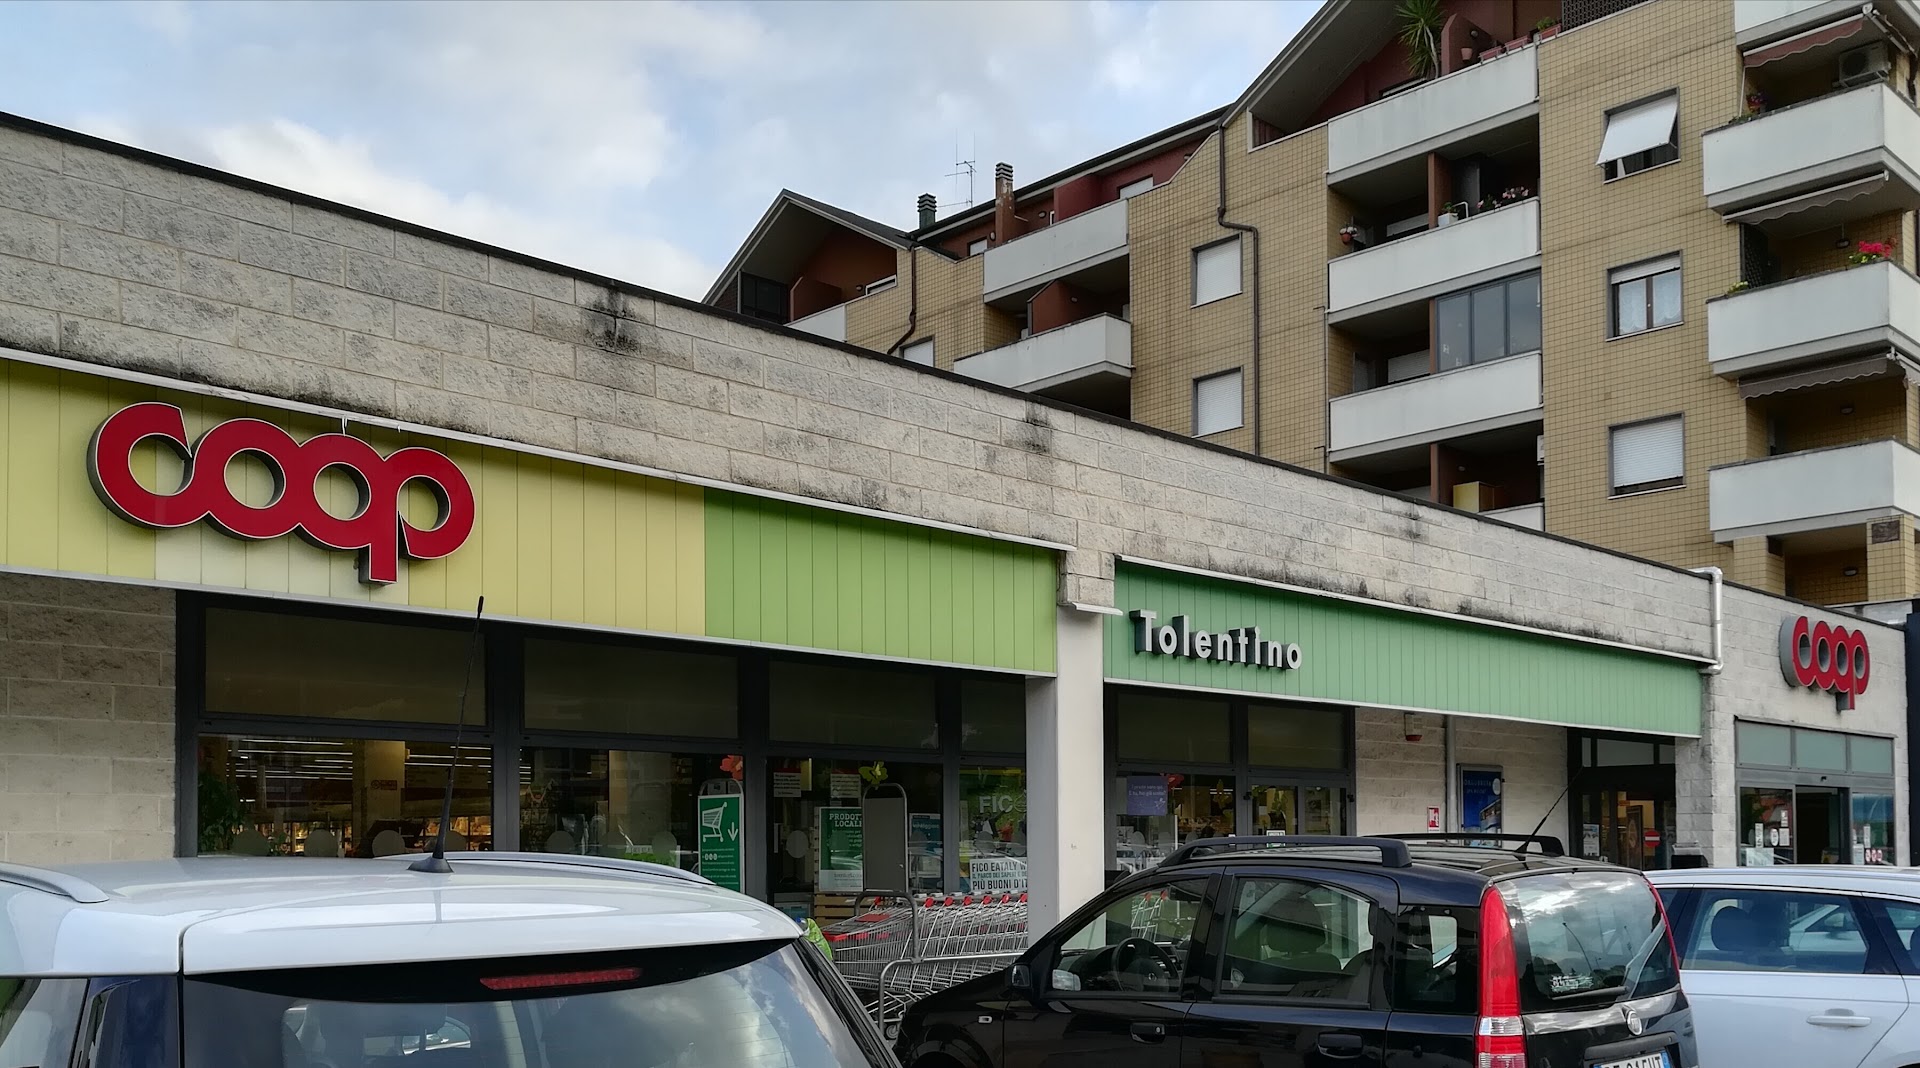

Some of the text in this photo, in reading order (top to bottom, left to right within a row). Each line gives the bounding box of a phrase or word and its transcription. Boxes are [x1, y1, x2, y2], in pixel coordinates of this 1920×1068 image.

[94, 401, 476, 583] coop
[1137, 608, 1303, 670] Tolentino
[1790, 615, 1871, 710] coop
[829, 813, 862, 821] PRODOT
[972, 862, 989, 872] FICO
[991, 861, 1018, 872] EATALY
[972, 879, 986, 891] PIÙ
[988, 880, 1012, 890] BUONI
